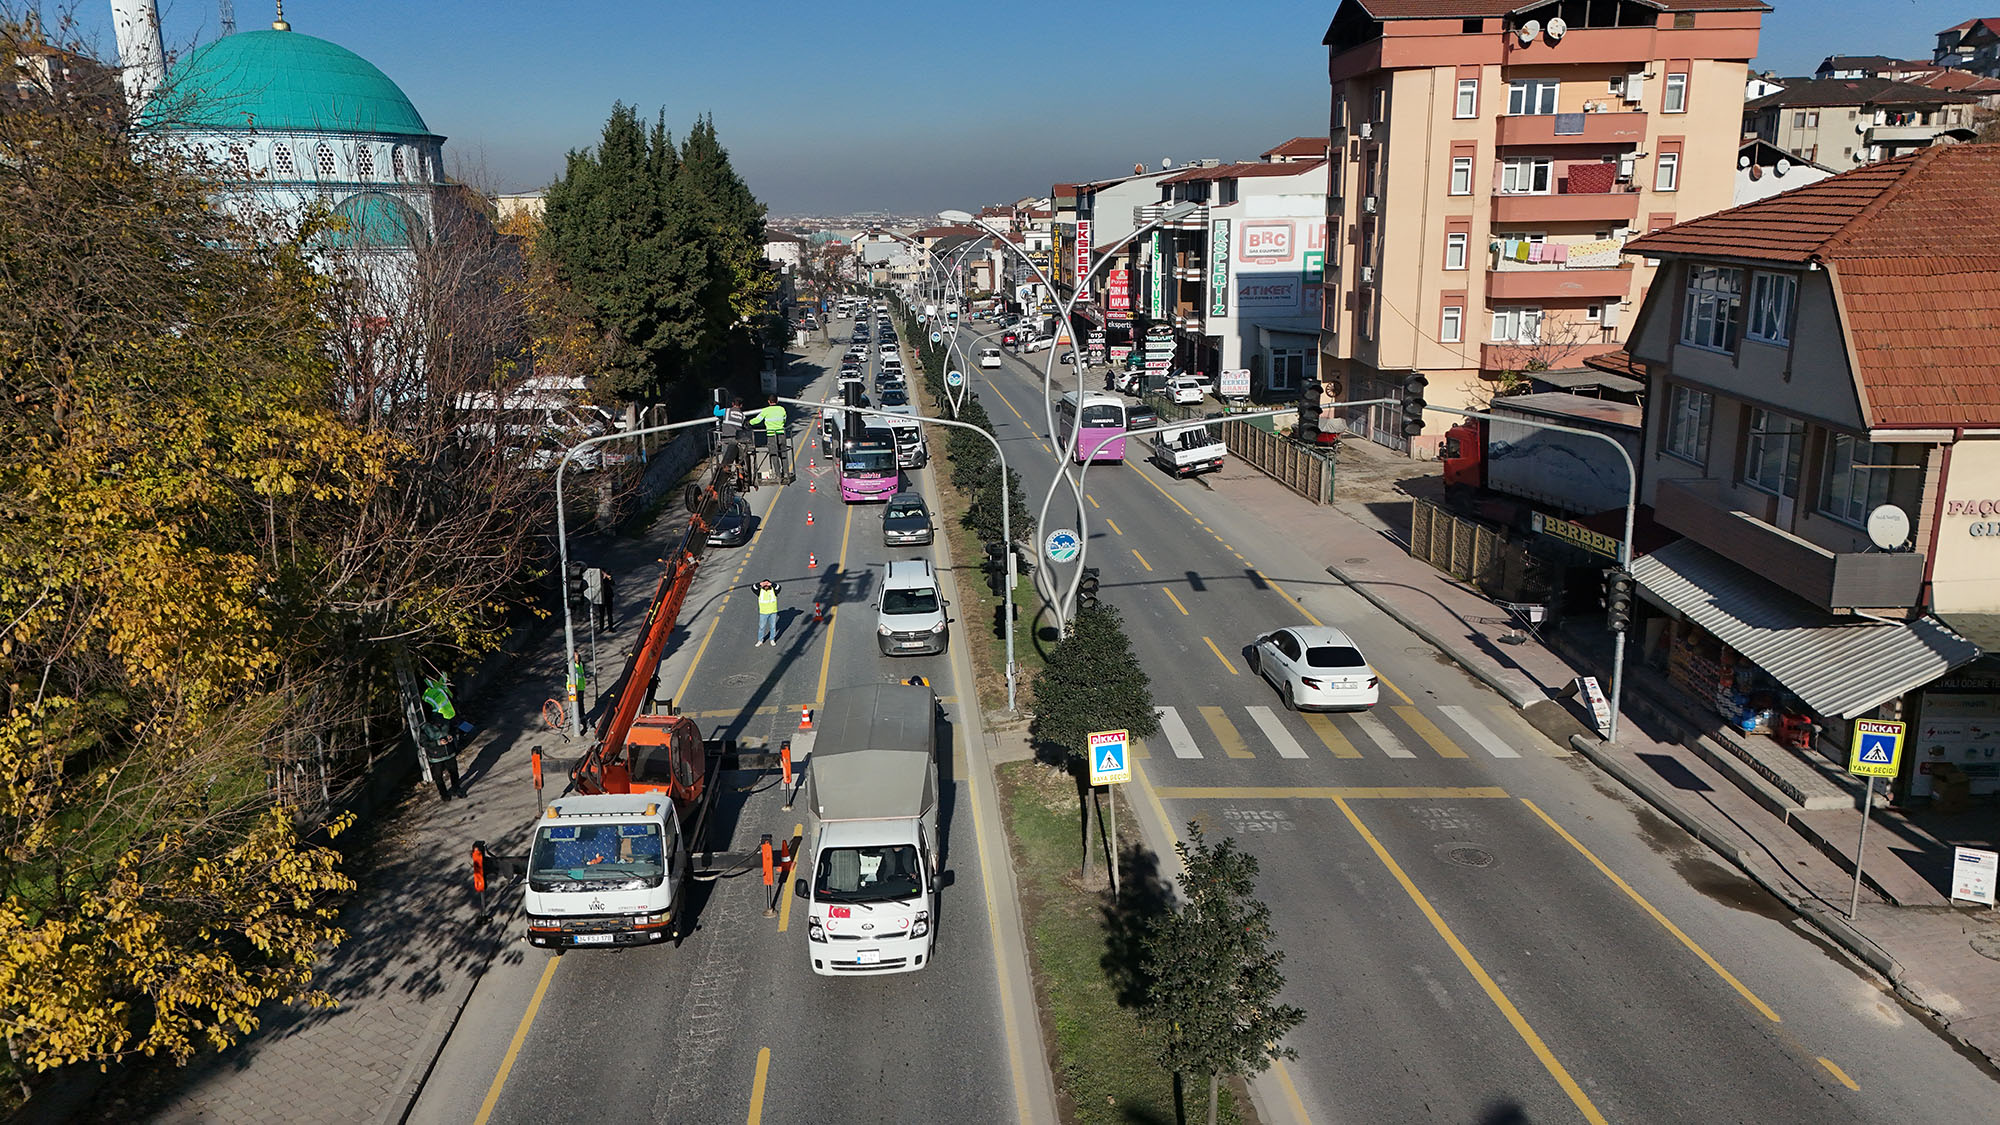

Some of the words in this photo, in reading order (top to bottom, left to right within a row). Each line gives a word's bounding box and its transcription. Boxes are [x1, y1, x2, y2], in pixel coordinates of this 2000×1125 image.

[1249, 231, 1286, 247] BRC
[1078, 222, 1088, 299] EKSPERTZ
[1108, 321, 1134, 329] eksperti
[1544, 516, 1617, 555] BERBER
[1860, 722, 1900, 734] DİKKAT
[1092, 733, 1125, 744] DİKKAT
